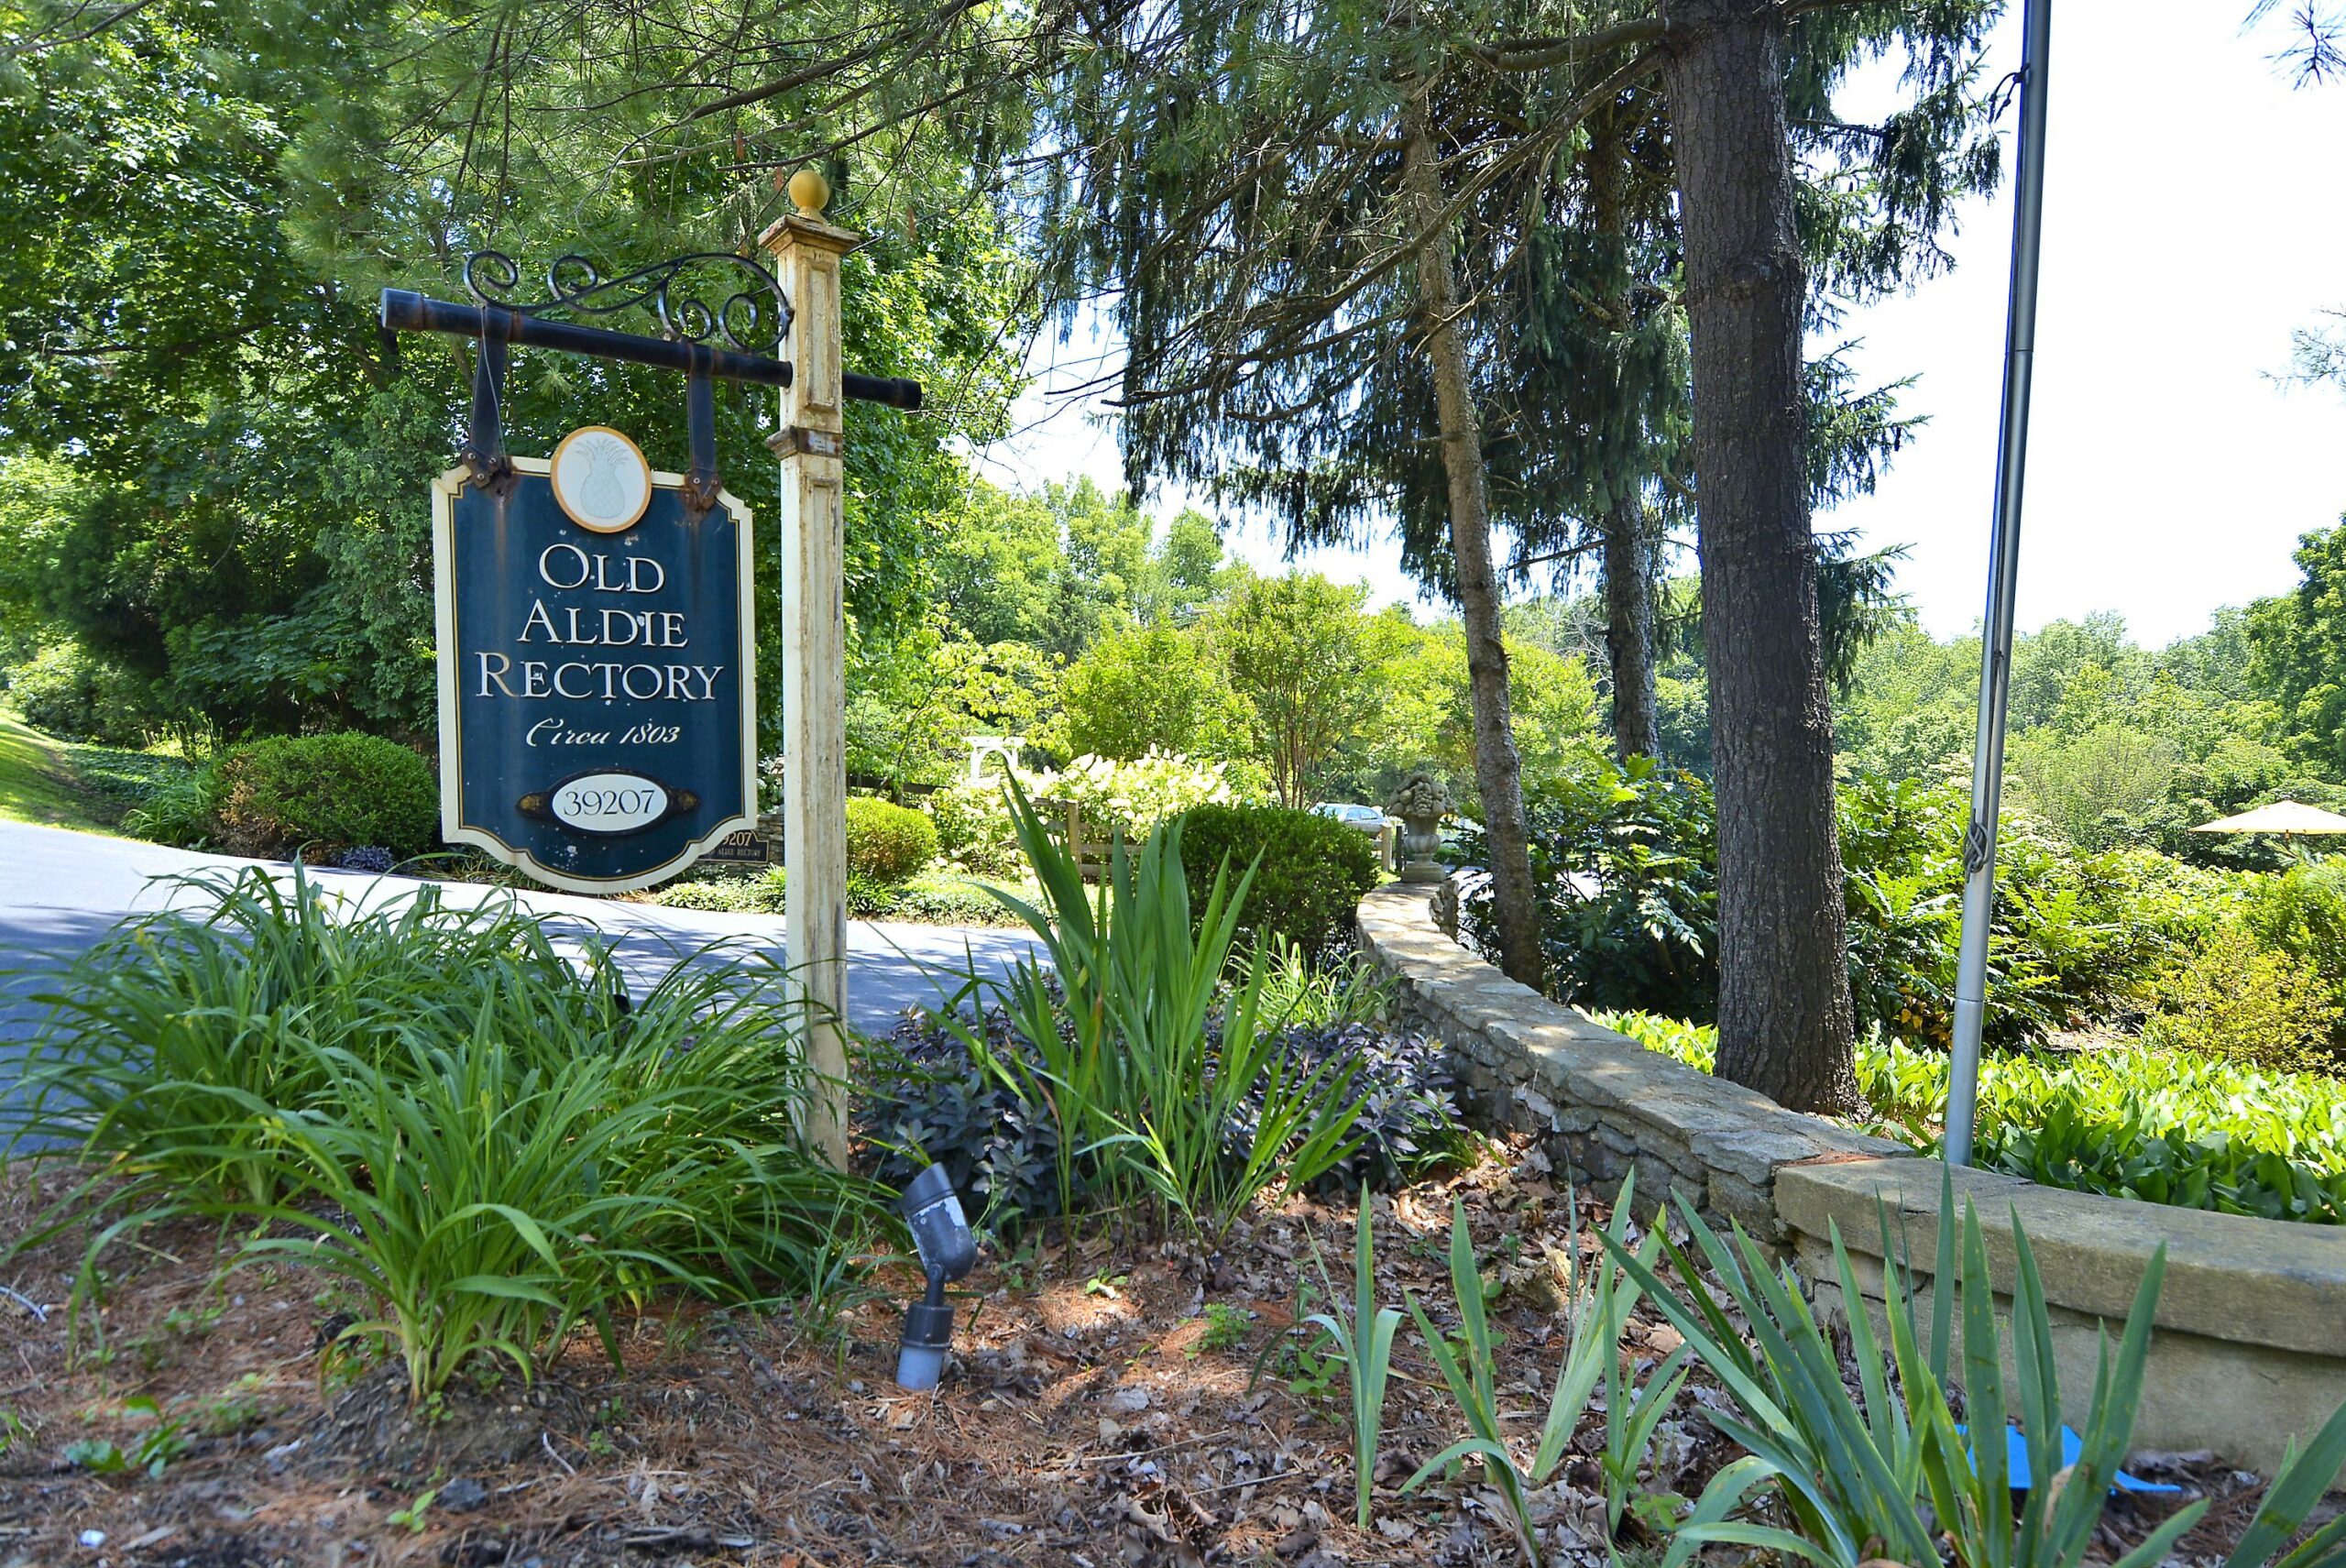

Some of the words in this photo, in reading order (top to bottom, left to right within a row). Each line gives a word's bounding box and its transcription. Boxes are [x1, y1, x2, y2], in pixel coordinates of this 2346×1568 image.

[539, 543, 665, 593] OLD
[517, 598, 688, 648] ALDIE
[475, 652, 724, 702] RECTORY
[526, 718, 612, 747] Circa
[619, 722, 681, 745] 1803
[563, 789, 655, 817] 39207
